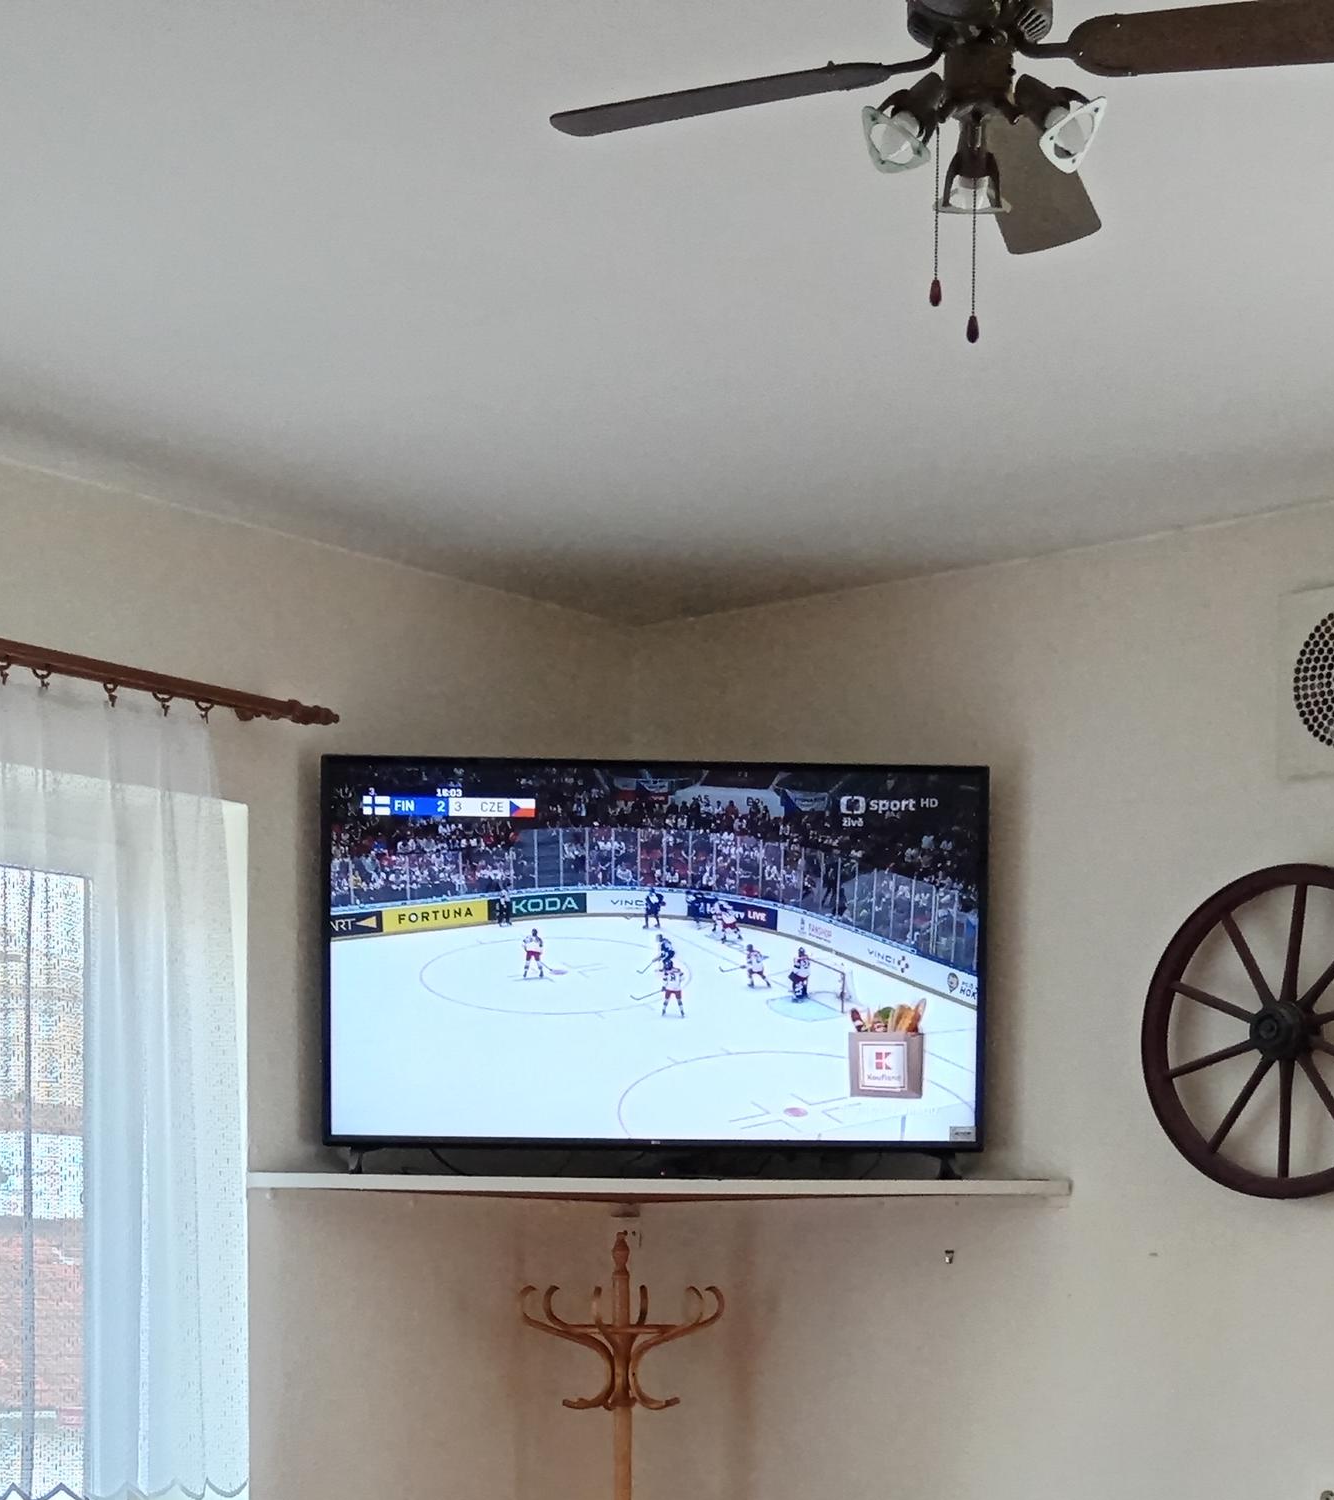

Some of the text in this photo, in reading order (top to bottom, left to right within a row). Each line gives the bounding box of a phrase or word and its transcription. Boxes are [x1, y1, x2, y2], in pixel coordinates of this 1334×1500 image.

[394, 800, 446, 812] FIN 2
[454, 802, 504, 813] 3 CZE
[869, 798, 939, 814] sport HD
[496, 897, 579, 917] KODA
[398, 907, 474, 925] FORTUNA
[747, 910, 767, 922] LIVE
